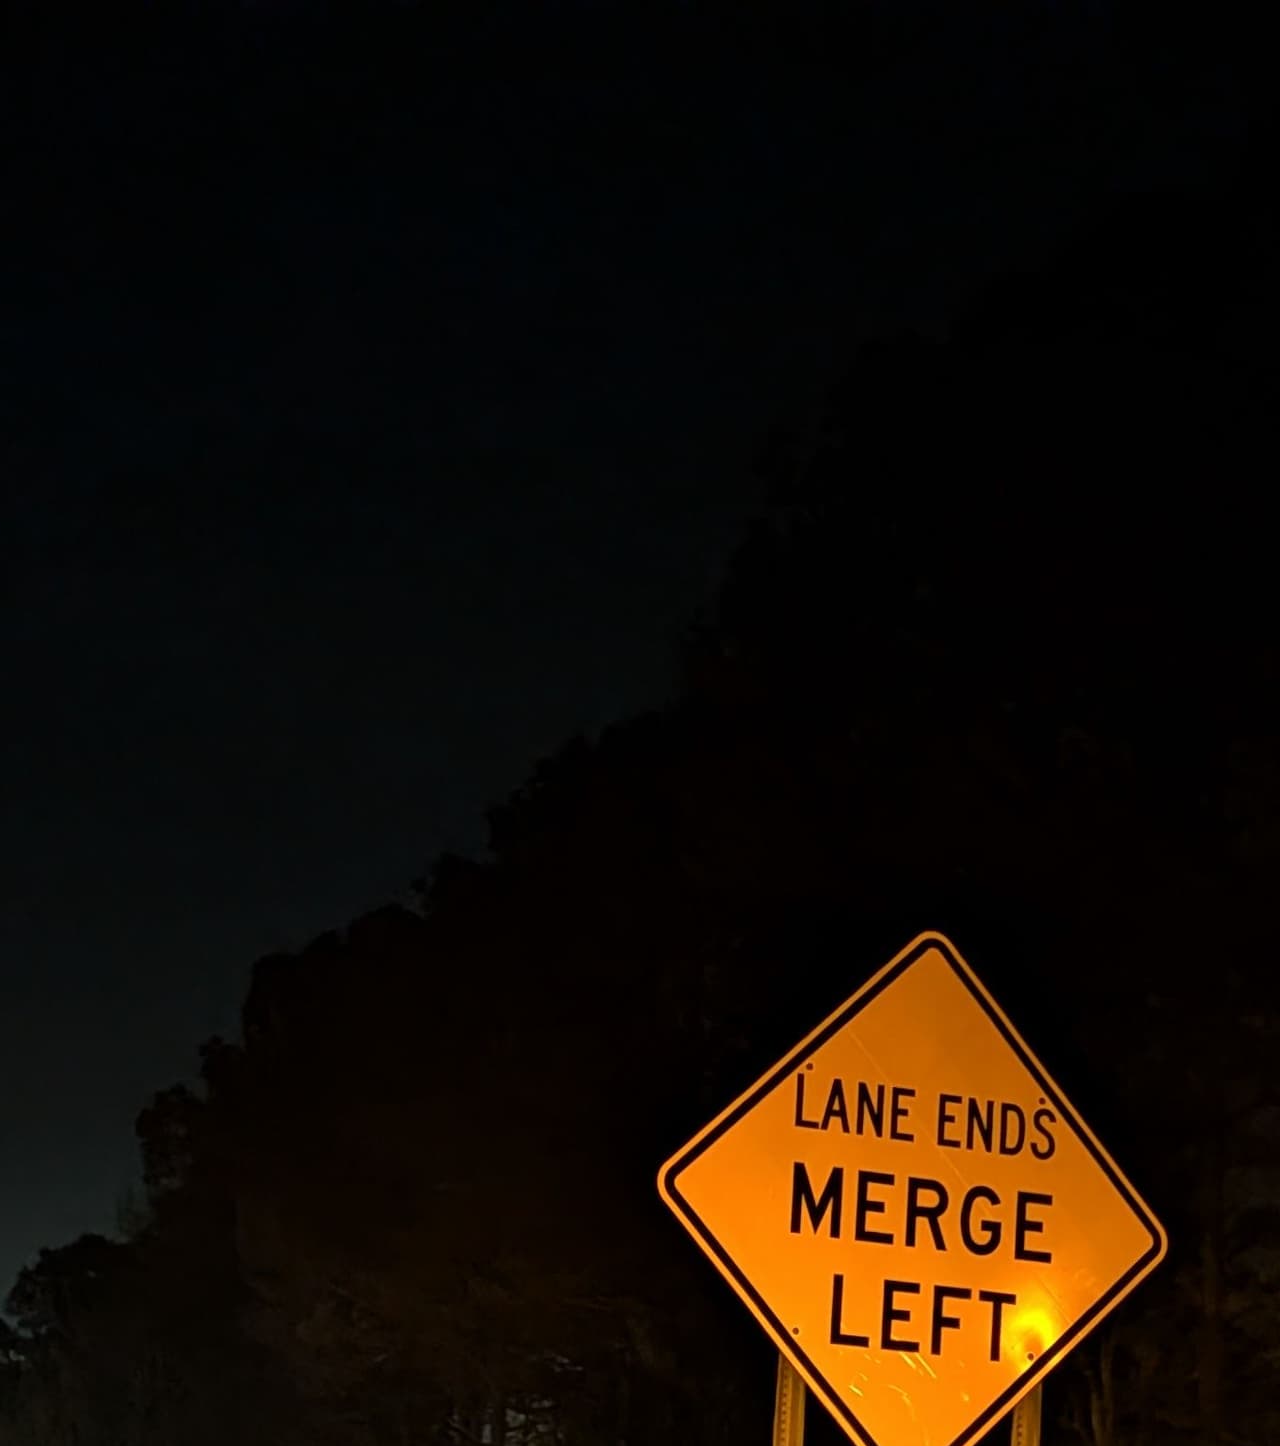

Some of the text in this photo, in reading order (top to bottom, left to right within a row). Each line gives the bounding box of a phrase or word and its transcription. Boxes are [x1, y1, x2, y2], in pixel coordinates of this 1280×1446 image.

[795, 1073, 1057, 1160] LANE ENDS
[790, 1162, 1053, 1264] MERGE
[830, 1274, 1016, 1362] LEFT
